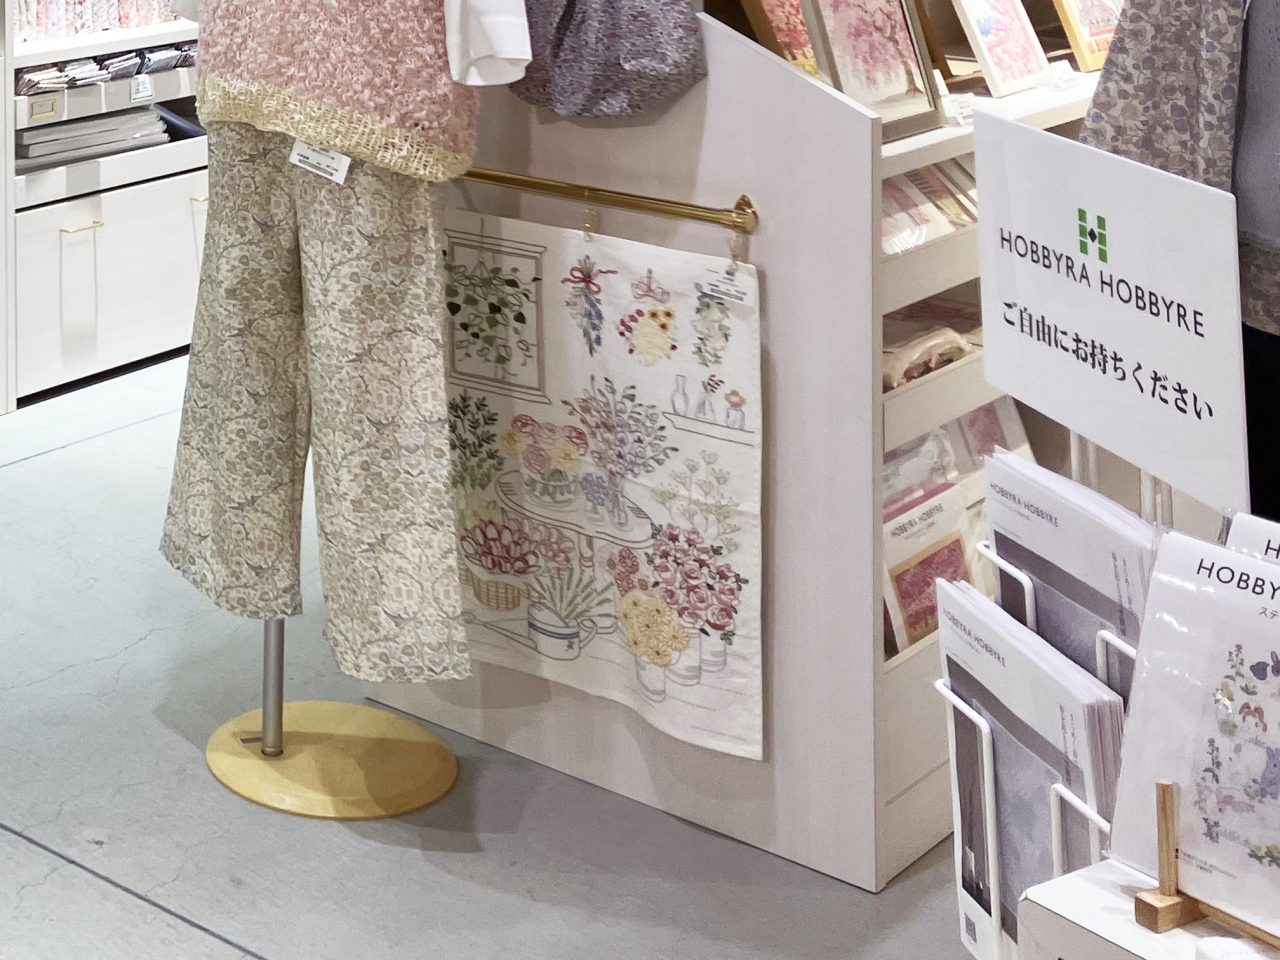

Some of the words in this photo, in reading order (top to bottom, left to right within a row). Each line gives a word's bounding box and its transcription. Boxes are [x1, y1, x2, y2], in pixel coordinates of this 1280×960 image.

[999, 227, 1091, 288] HOBBYRA
[1099, 270, 1205, 338] HOBBYRE
[1003, 301, 1213, 420] ご自由にお持ちください
[1023, 501, 1059, 528] HOBBYRE
[1196, 558, 1280, 600] HOBBY
